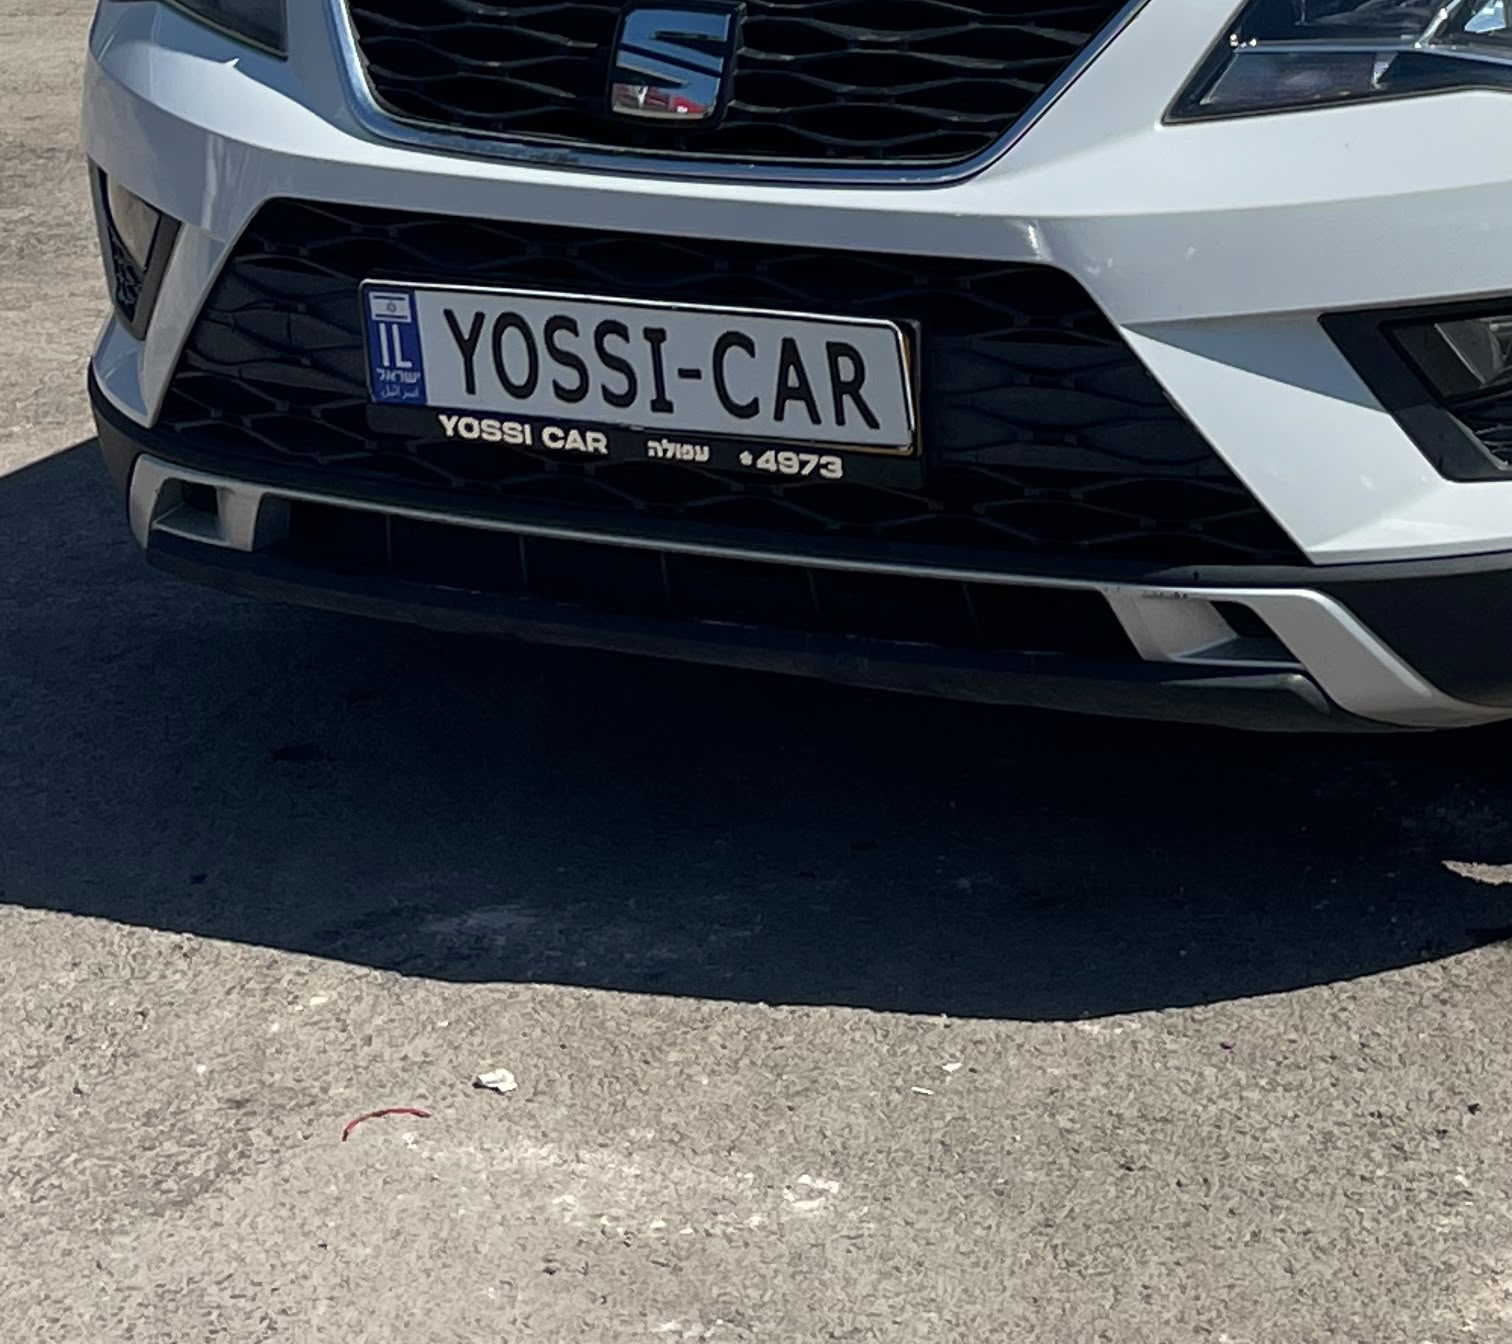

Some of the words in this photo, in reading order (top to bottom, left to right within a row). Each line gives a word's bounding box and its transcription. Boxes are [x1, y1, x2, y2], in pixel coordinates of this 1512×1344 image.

[379, 322, 413, 368] IL
[442, 307, 880, 431] YOSSI-CAR
[438, 414, 534, 446] YOSSI
[542, 425, 608, 455] CAR
[647, 439, 710, 462] עפולה
